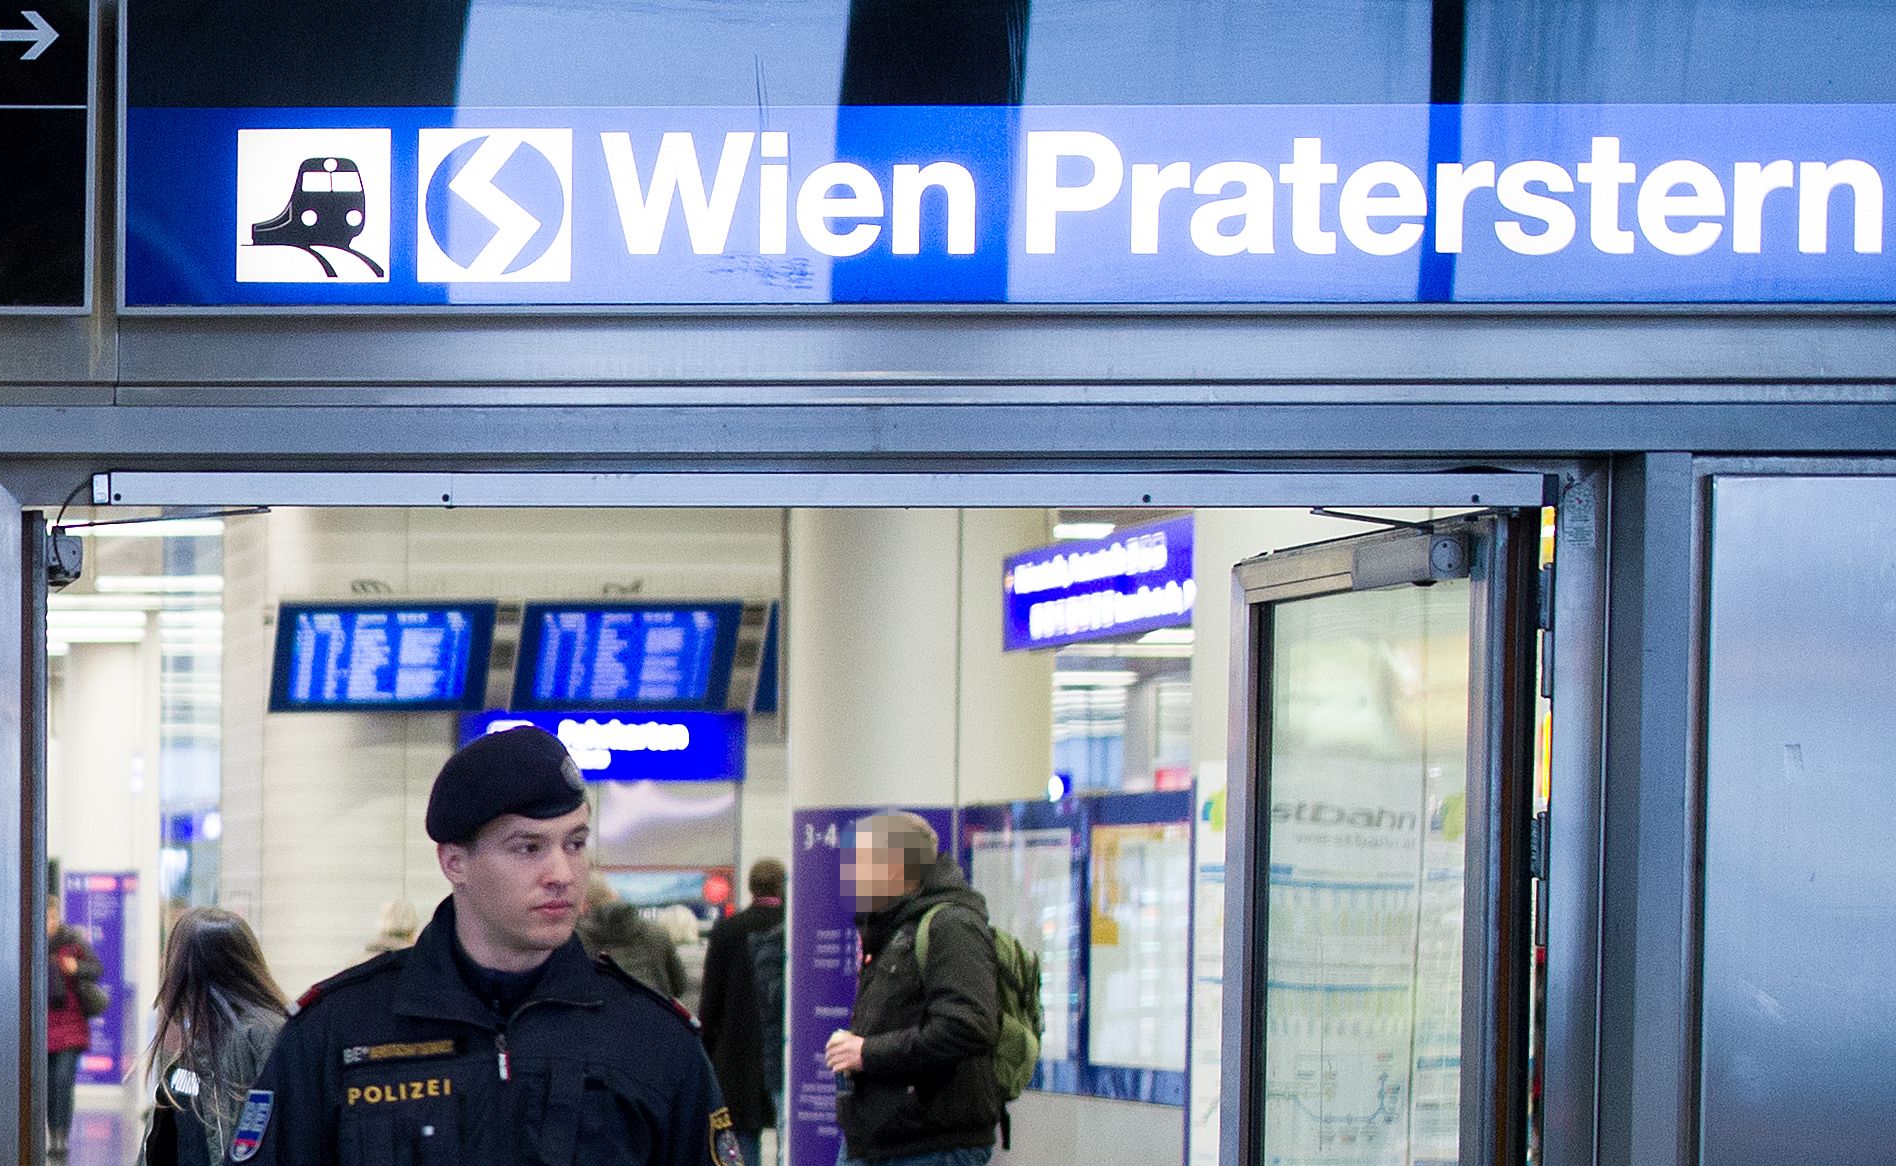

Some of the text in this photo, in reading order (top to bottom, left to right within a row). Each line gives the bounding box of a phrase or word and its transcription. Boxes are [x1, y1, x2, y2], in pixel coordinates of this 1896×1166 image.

[600, 130, 1883, 256] Wien Praterstern
[347, 1079, 452, 1105] POLIZEI
